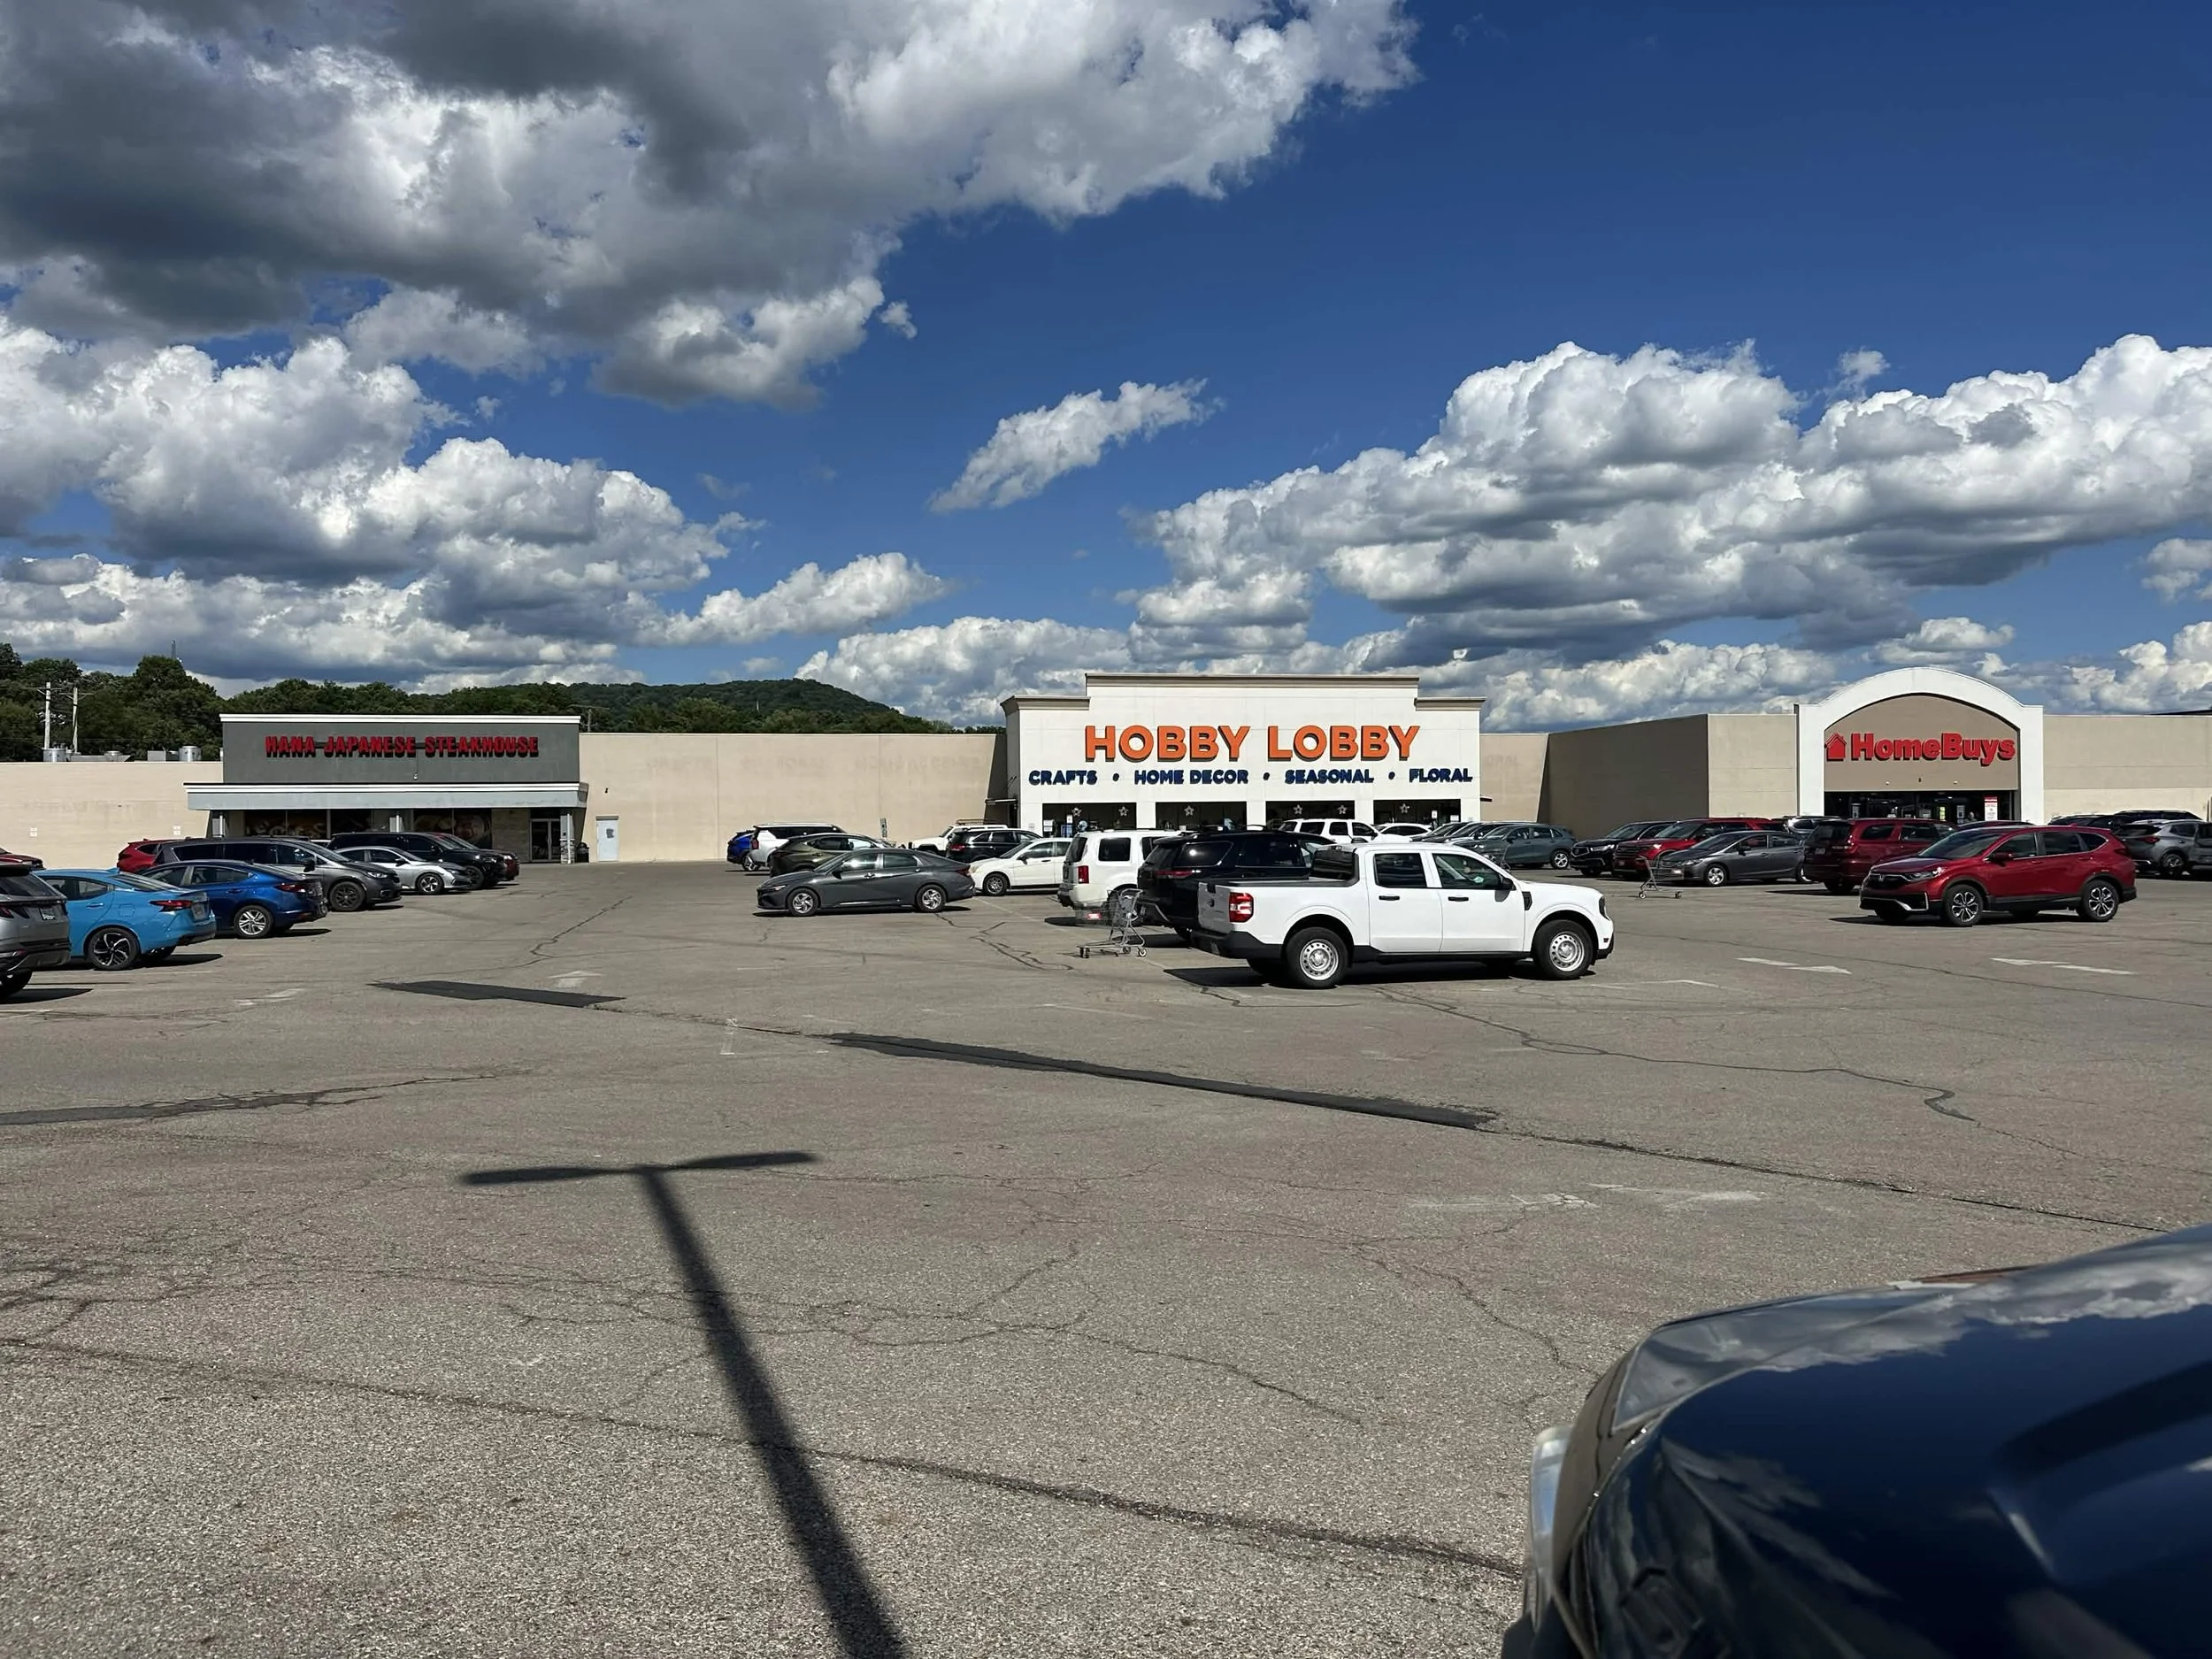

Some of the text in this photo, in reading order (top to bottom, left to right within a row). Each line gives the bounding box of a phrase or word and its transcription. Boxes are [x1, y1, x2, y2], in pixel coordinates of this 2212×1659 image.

[265, 735, 539, 757] HANA JAPANESE STEAKHOUSE
[1085, 726, 1420, 761] HOBBY LOBBY
[1851, 733, 2016, 767] HomeBuys
[1028, 768, 1473, 786] CRAFTS HOME DECOR SEASONAL FLORAL
